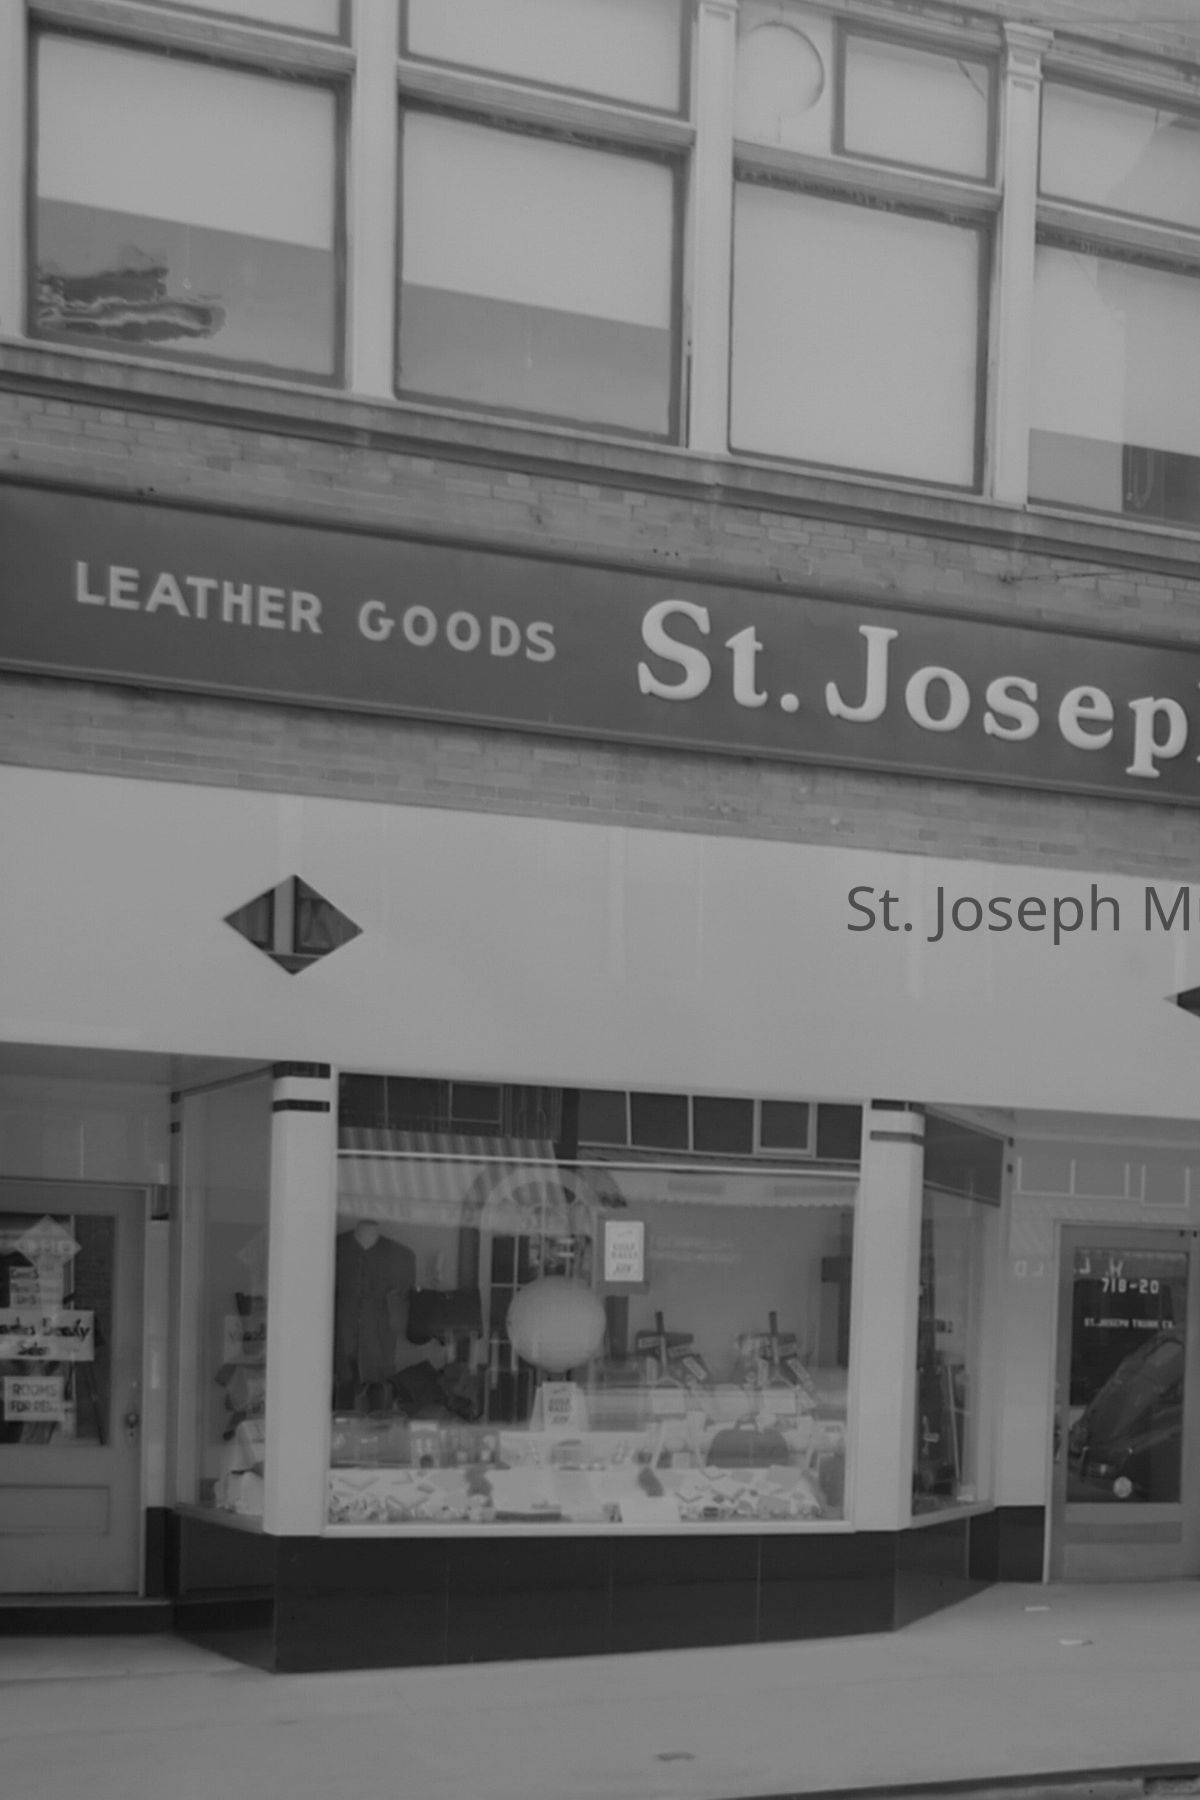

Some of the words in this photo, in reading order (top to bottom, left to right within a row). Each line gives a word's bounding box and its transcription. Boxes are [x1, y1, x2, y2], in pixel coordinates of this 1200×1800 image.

[75, 560, 323, 634] LEATHER
[357, 600, 557, 663] GOODS
[637, 599, 800, 713] St.
[1101, 1278, 1159, 1295] 718-20
